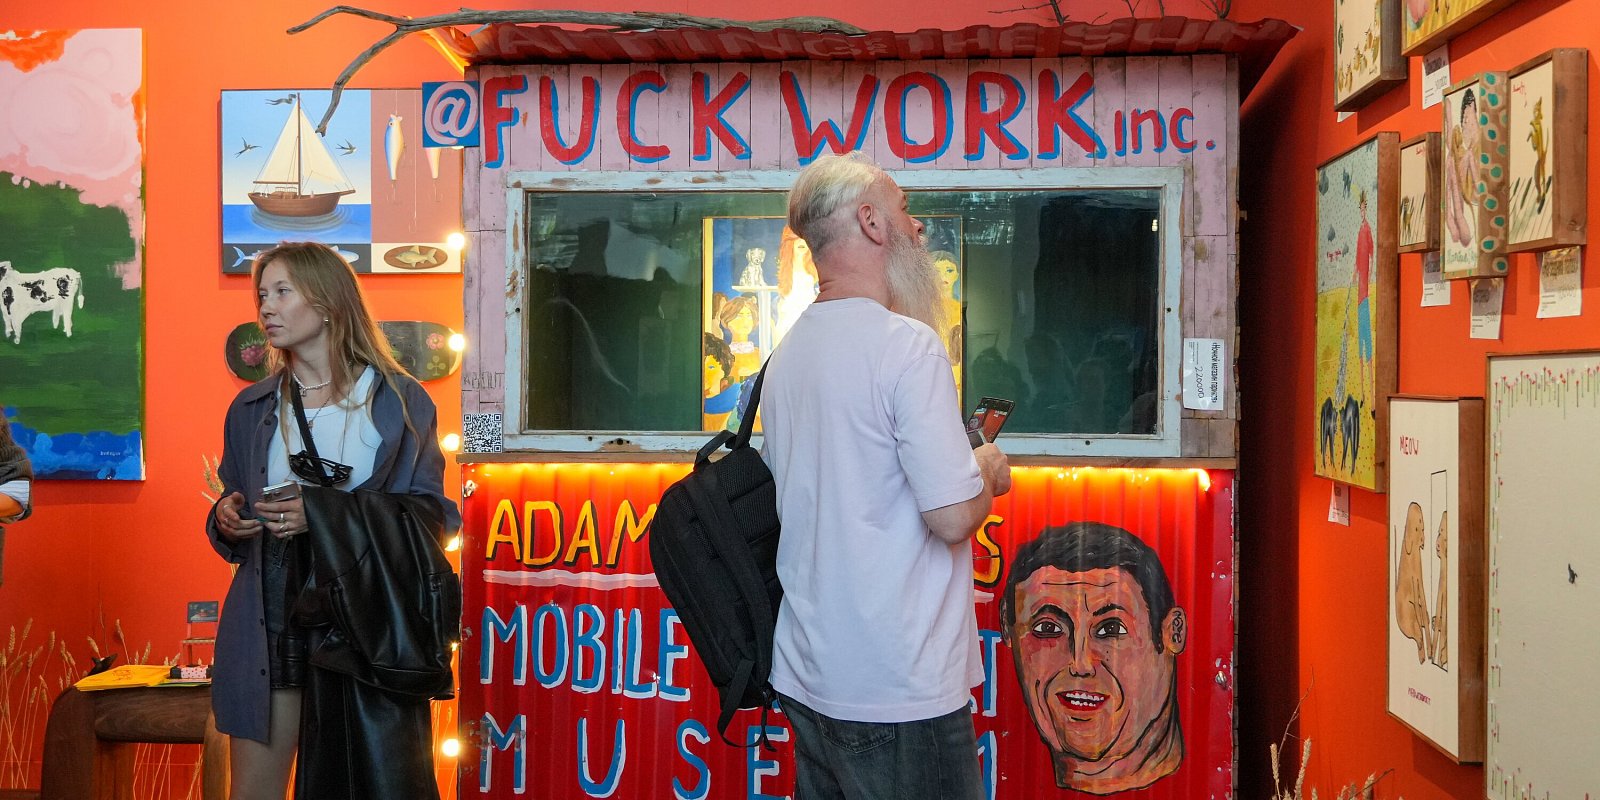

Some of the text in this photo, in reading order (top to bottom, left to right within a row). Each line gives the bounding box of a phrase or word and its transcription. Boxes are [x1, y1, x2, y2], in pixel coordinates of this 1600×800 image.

[779, 68, 1107, 166] WORK
[484, 499, 657, 568] ADAM
[479, 603, 690, 702] MOBILE
[479, 711, 998, 800] MUSE
